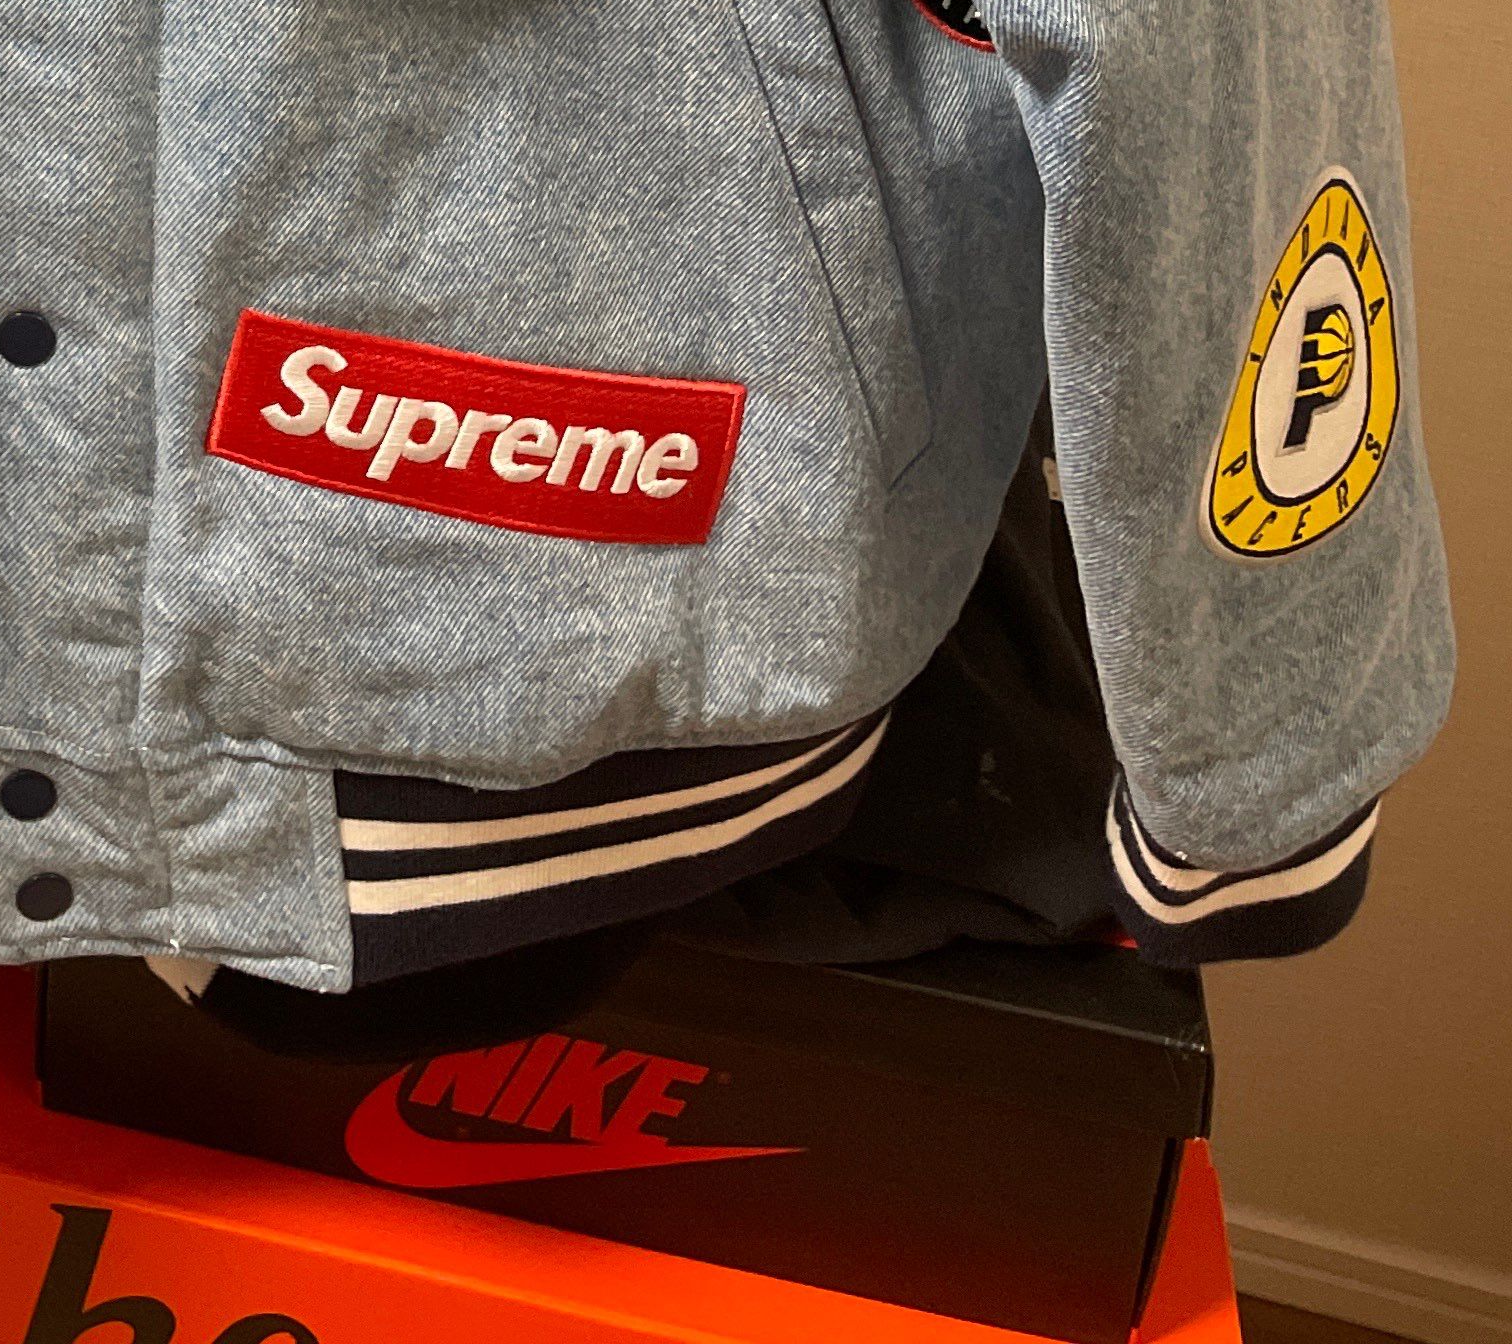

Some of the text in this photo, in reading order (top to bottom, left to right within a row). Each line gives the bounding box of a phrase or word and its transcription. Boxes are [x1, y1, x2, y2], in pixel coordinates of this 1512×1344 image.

[259, 344, 700, 499] Supreme
[1221, 432, 1384, 546] PACERS
[408, 1032, 710, 1147] NIKE
